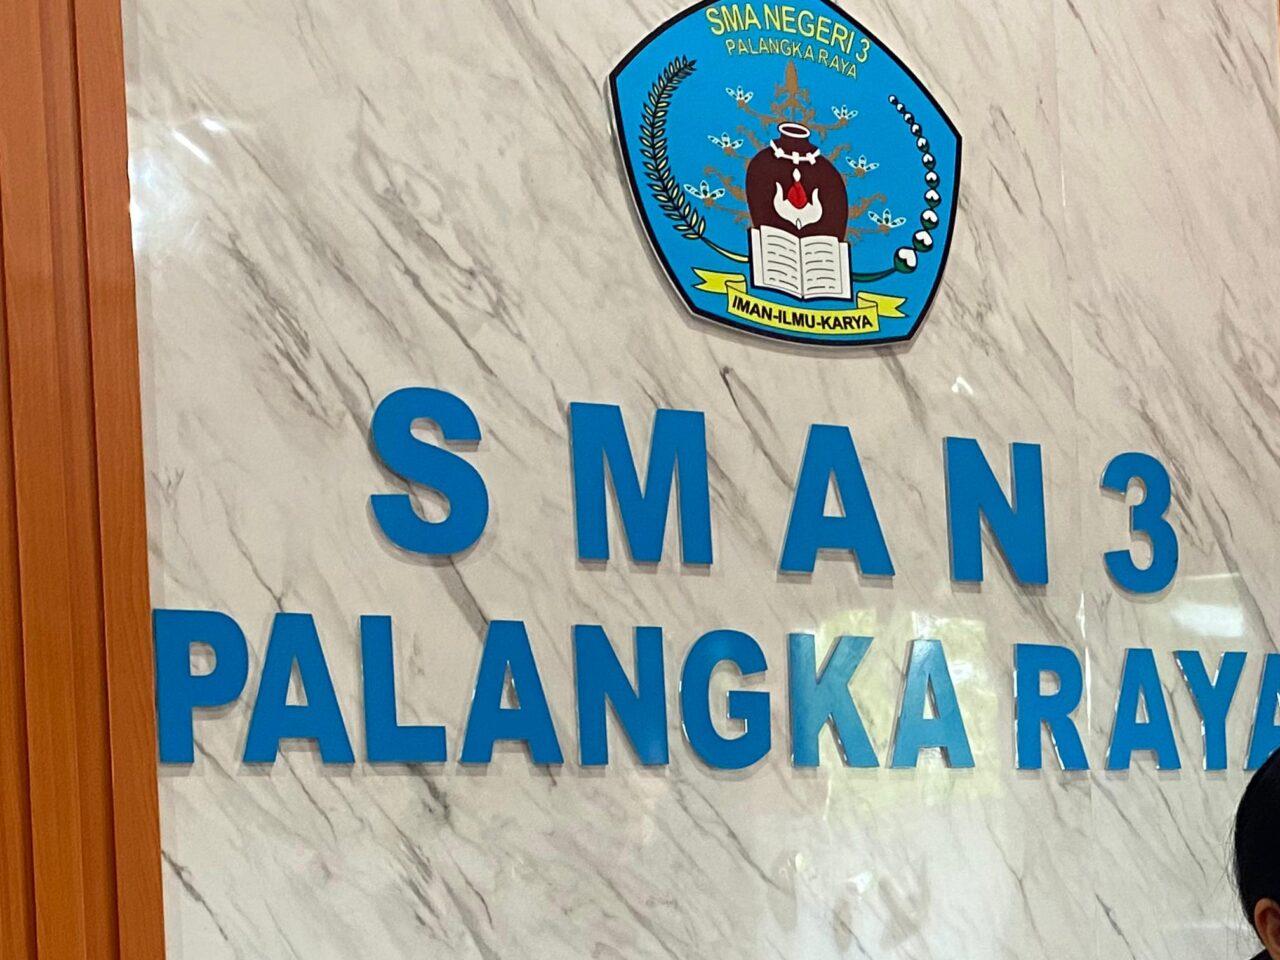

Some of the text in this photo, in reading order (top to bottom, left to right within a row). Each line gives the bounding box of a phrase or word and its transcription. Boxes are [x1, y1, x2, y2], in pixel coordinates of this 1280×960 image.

[706, 4, 871, 63] SMA NEGERI 3
[725, 37, 857, 79] PALANGKA RAYA
[732, 296, 873, 330] IMAN-ILMU-KARYA
[1101, 452, 1179, 594] 3
[153, 608, 976, 769] PALANGKA
